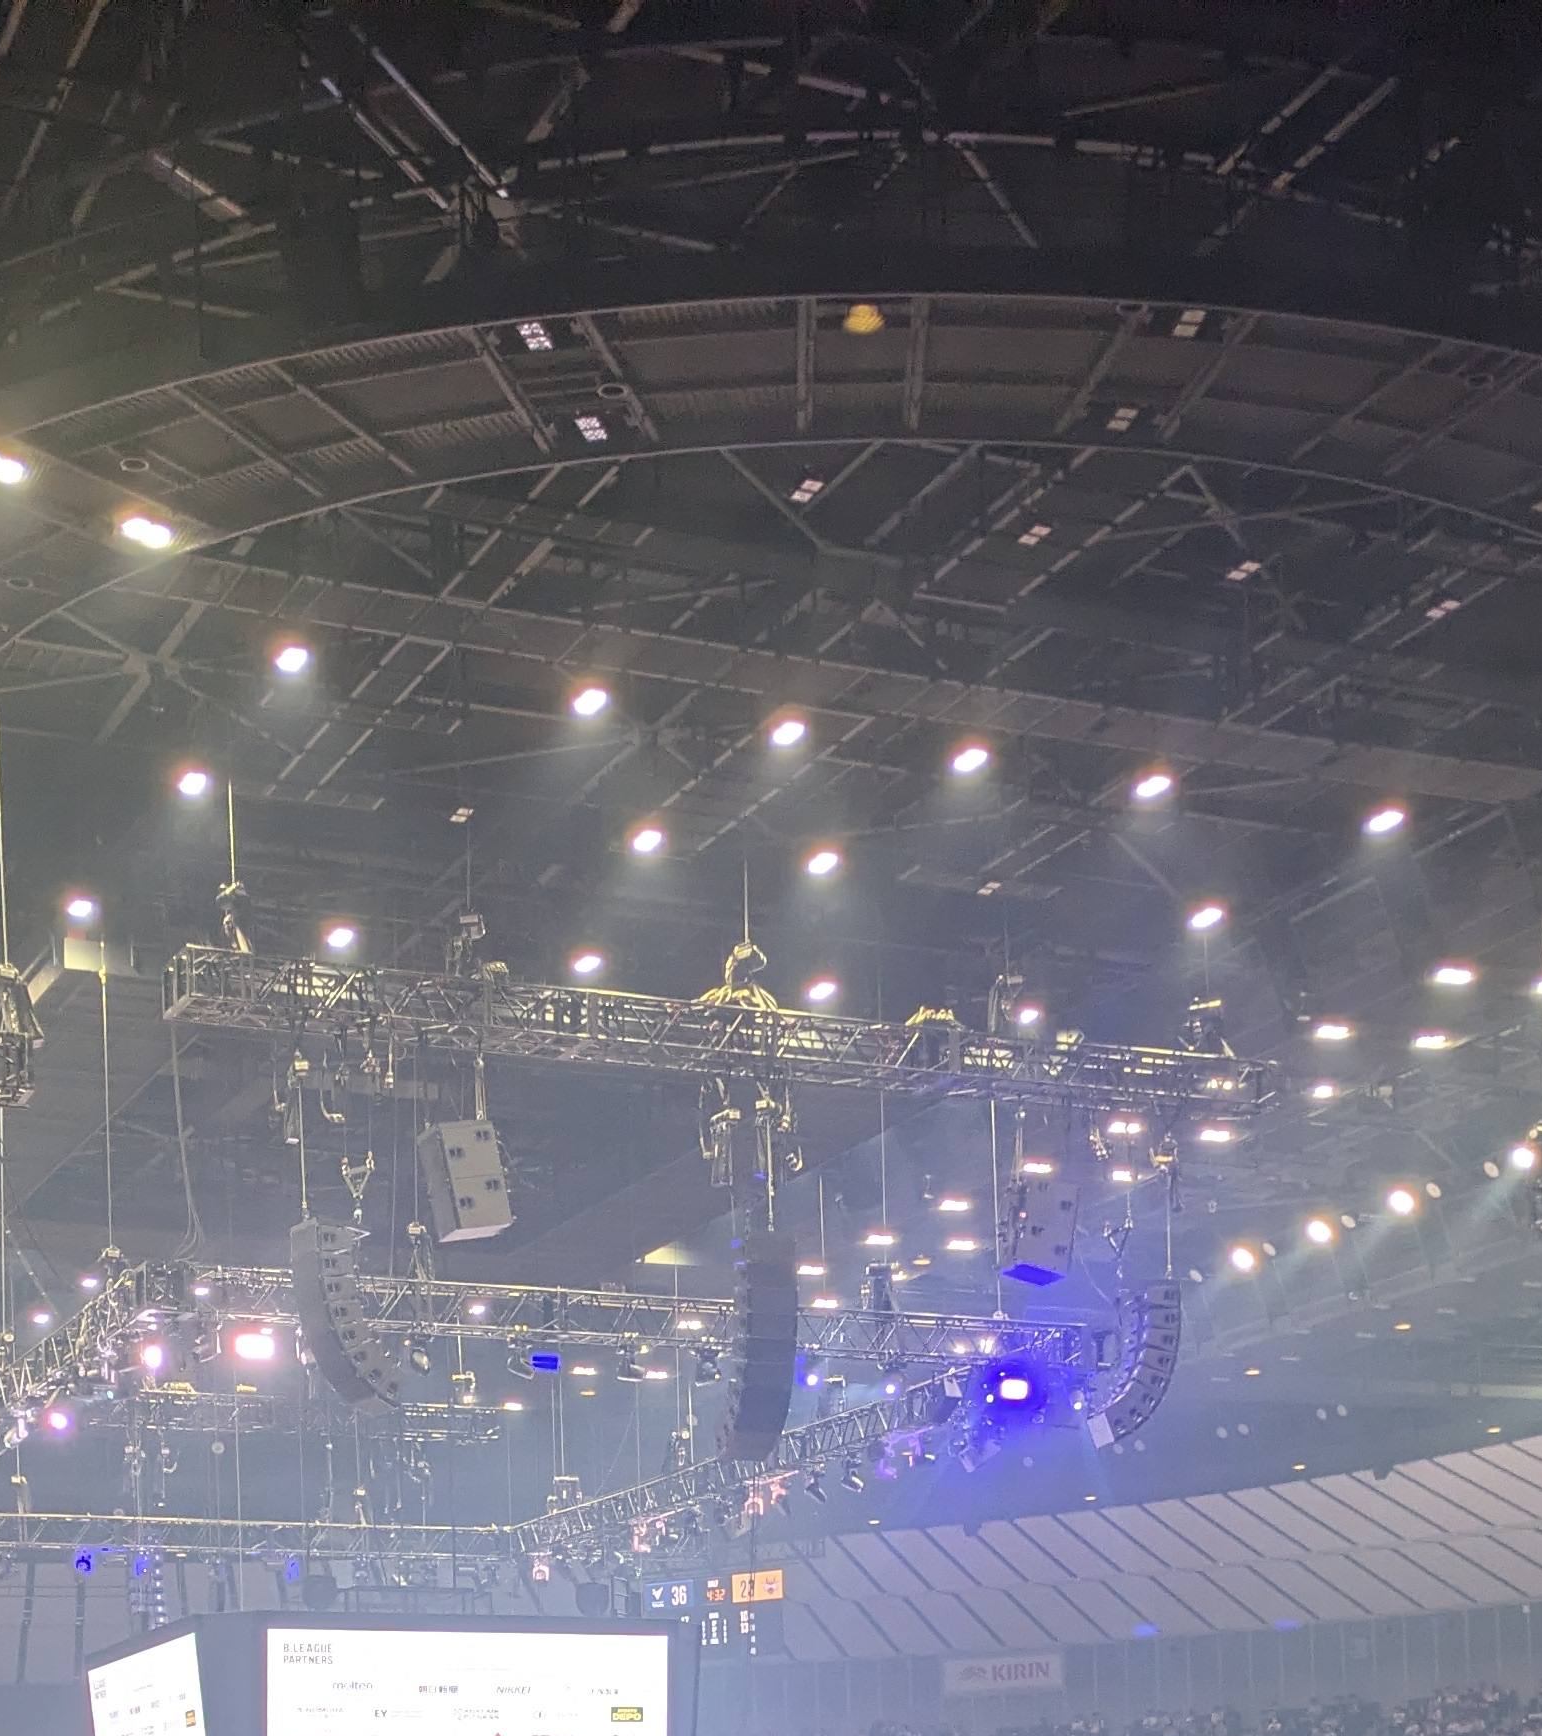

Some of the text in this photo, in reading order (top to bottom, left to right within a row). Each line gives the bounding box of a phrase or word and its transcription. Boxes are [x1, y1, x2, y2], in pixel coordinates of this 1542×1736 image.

[671, 1585, 687, 1606] 36
[283, 1643, 334, 1653] B.LEAGUE
[283, 1655, 334, 1665] PARTNERS
[991, 1662, 1050, 1682] KIRIN
[332, 1681, 373, 1690] molten
[496, 1686, 531, 1694] NIKKEI
[374, 1709, 388, 1718] EY
